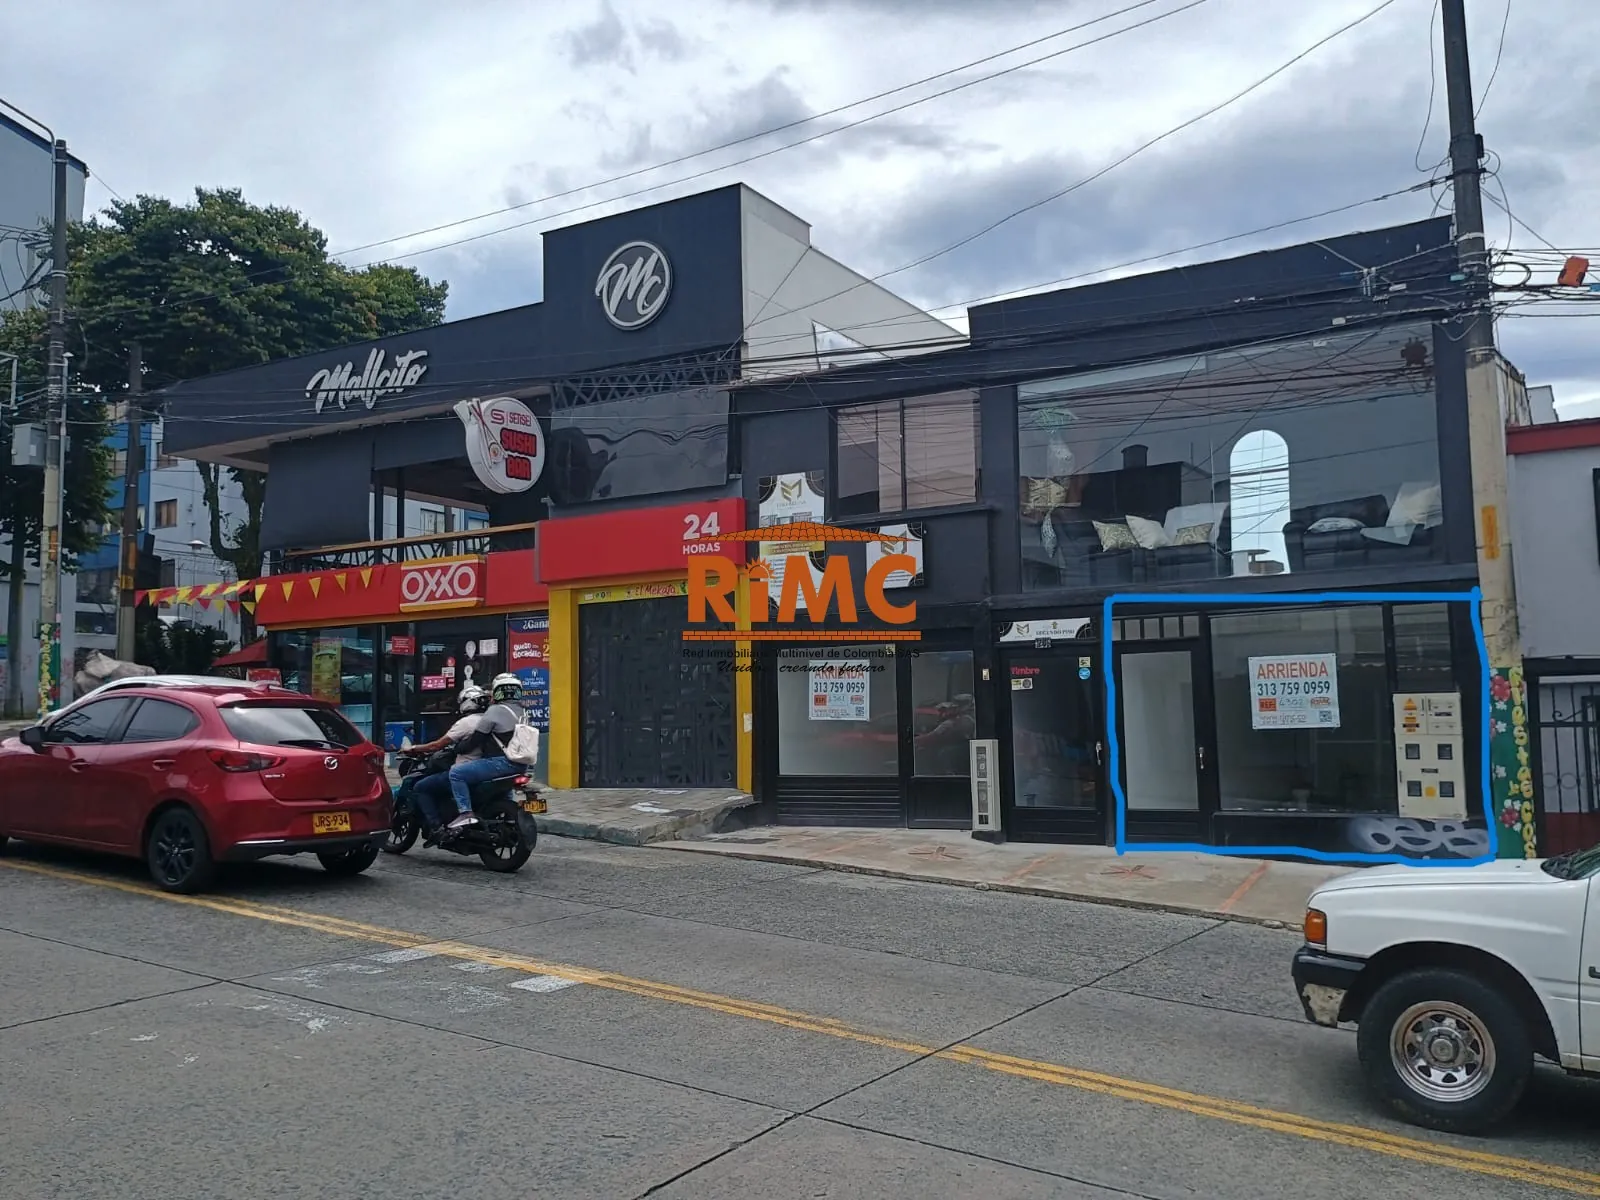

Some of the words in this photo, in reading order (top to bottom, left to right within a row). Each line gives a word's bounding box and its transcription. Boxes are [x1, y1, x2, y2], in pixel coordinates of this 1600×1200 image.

[683, 511, 721, 541] 24
[682, 542, 721, 555] HORAS
[401, 564, 476, 603] OXXO
[1009, 666, 1040, 676] Timbre
[1256, 661, 1329, 680] ARRIENDA
[814, 681, 828, 693] 313
[830, 681, 844, 693] 759
[846, 681, 865, 693] 0959
[1257, 683, 1277, 696] 313
[1280, 682, 1300, 695] 759
[1303, 680, 1331, 694] 0959
